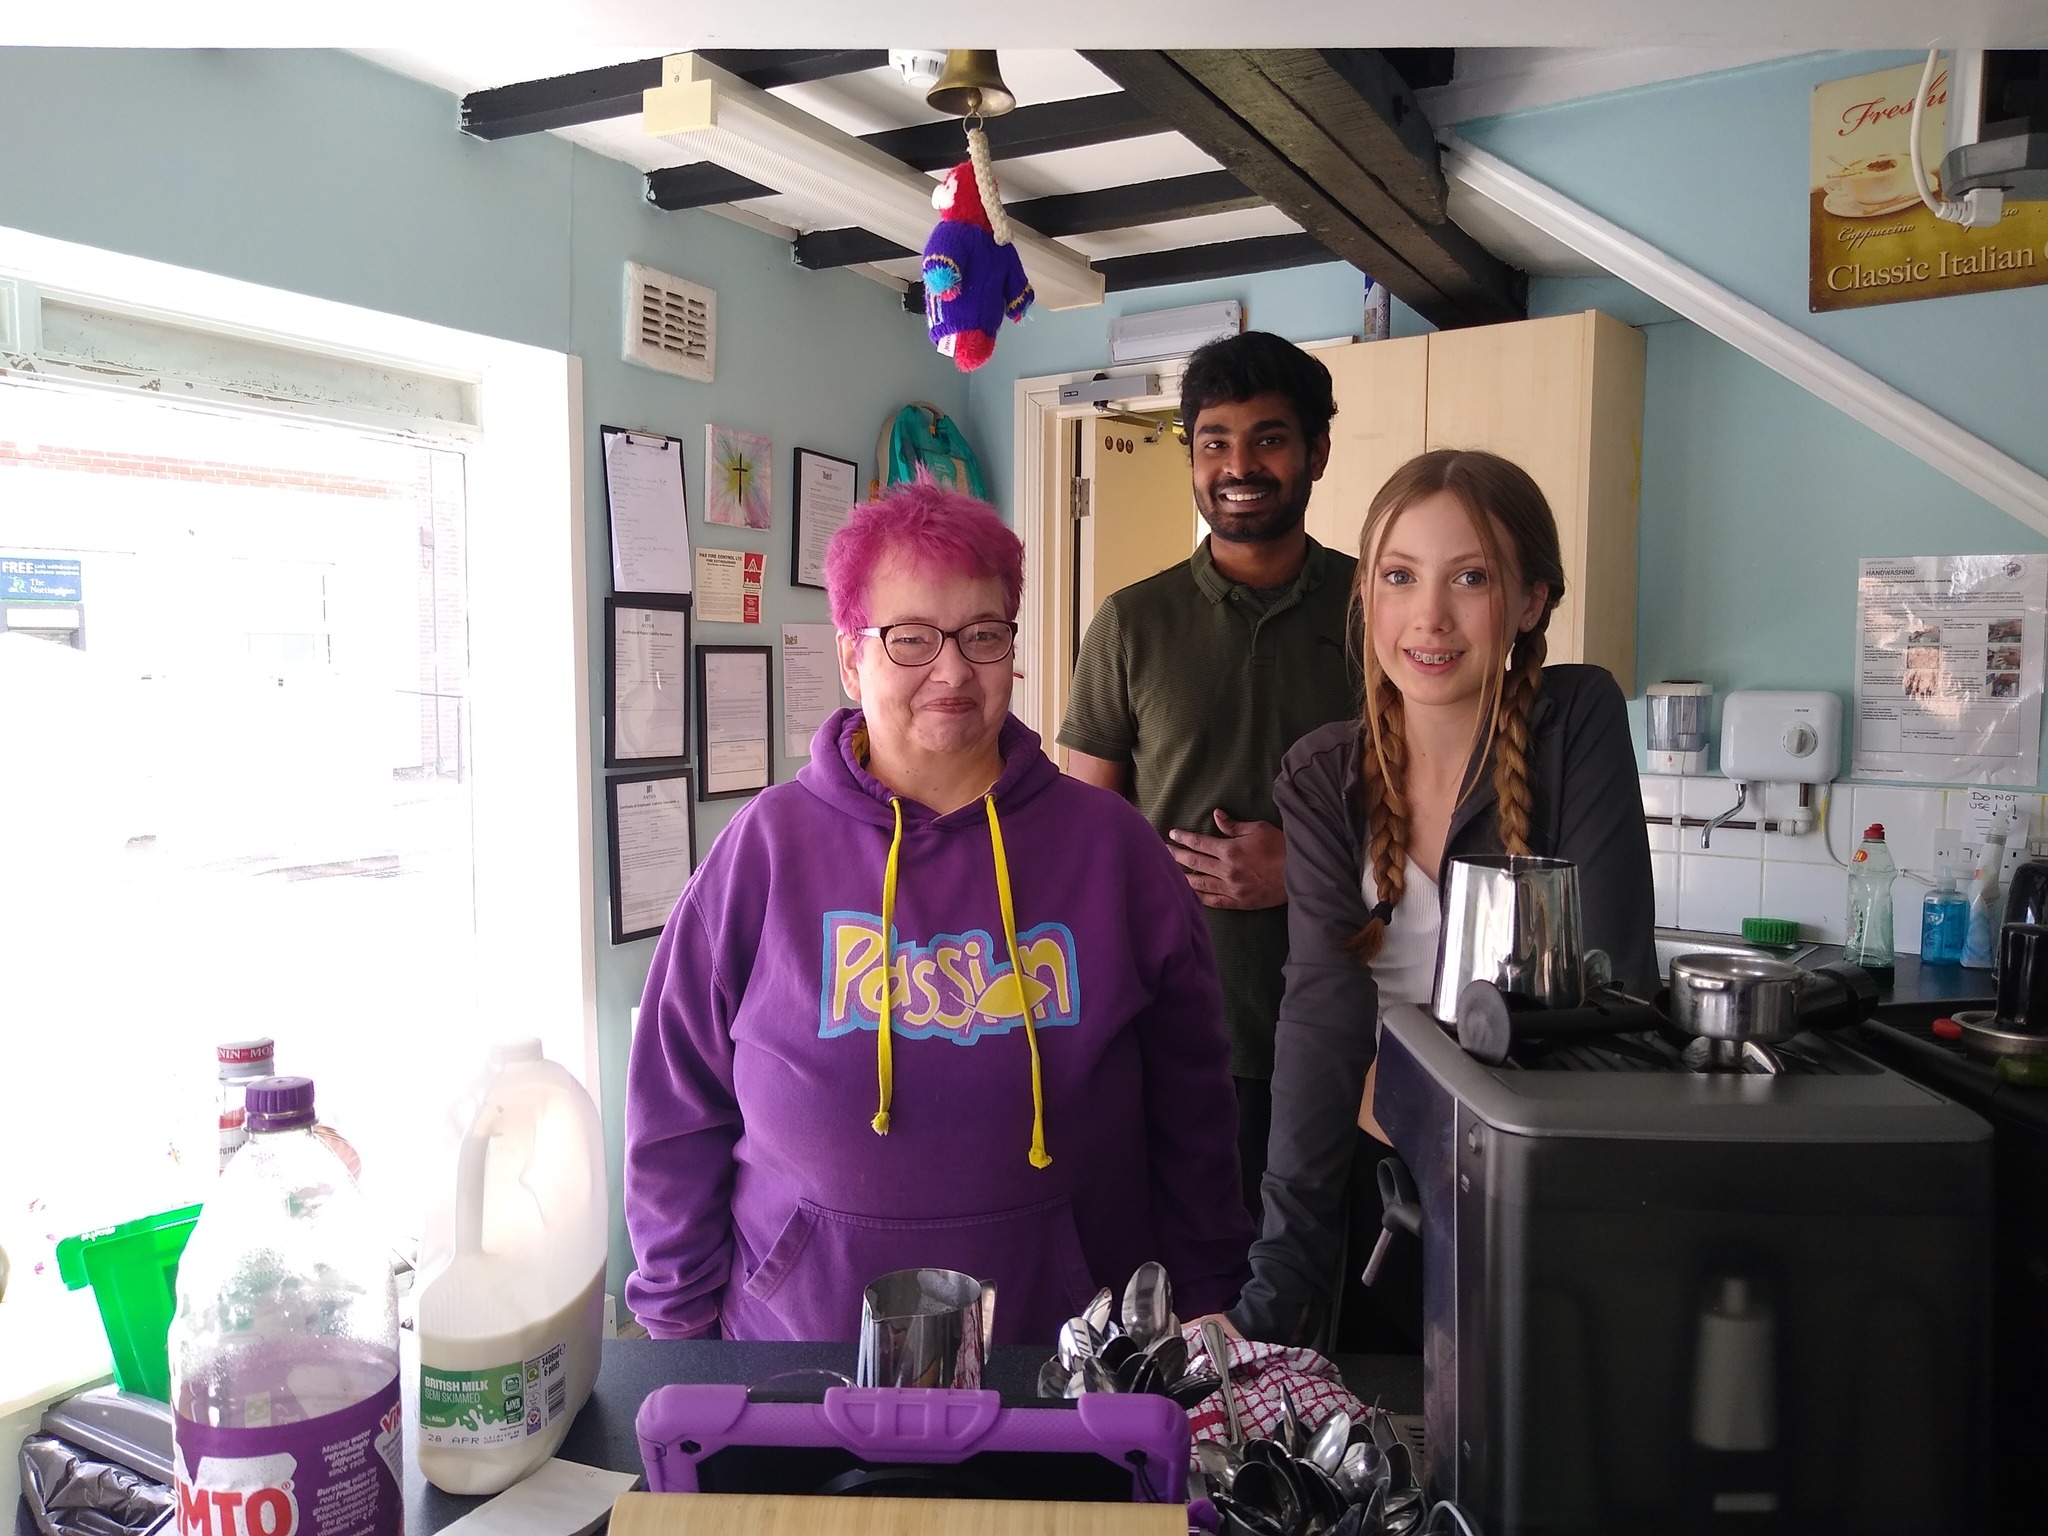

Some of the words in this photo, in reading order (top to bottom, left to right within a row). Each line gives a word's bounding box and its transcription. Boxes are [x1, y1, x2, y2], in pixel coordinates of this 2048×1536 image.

[1838, 222, 1916, 251] Cappuccino
[1827, 257, 1931, 292] Classic
[1938, 245, 2035, 279] Italian
[1, 561, 34, 574] FREE
[1866, 569, 1915, 577] HANDWASHING
[30, 578, 45, 586] The
[1972, 791, 1990, 801] DO
[1969, 802, 1991, 811] USE
[833, 925, 1070, 1034] Passion
[218, 1048, 241, 1059] NIN
[425, 1376, 460, 1392] BRITISH
[462, 1380, 489, 1392] MILK
[425, 1388, 441, 1402] SEMI
[442, 1392, 481, 1404] SKIMMED
[506, 1397, 520, 1407] LIVE
[432, 1416, 446, 1424] ASDA
[322, 1440, 350, 1455] Making
[351, 1429, 371, 1444] water
[428, 1433, 442, 1443] 28
[452, 1436, 480, 1445] APR
[324, 1439, 370, 1463] refreshingly
[331, 1449, 365, 1468] different
[328, 1465, 348, 1478] since
[317, 1480, 351, 1497] Bursting
[352, 1472, 367, 1485] with
[320, 1492, 336, 1504] real
[175, 1477, 293, 1536] MTO
[322, 1519, 335, 1529] the
